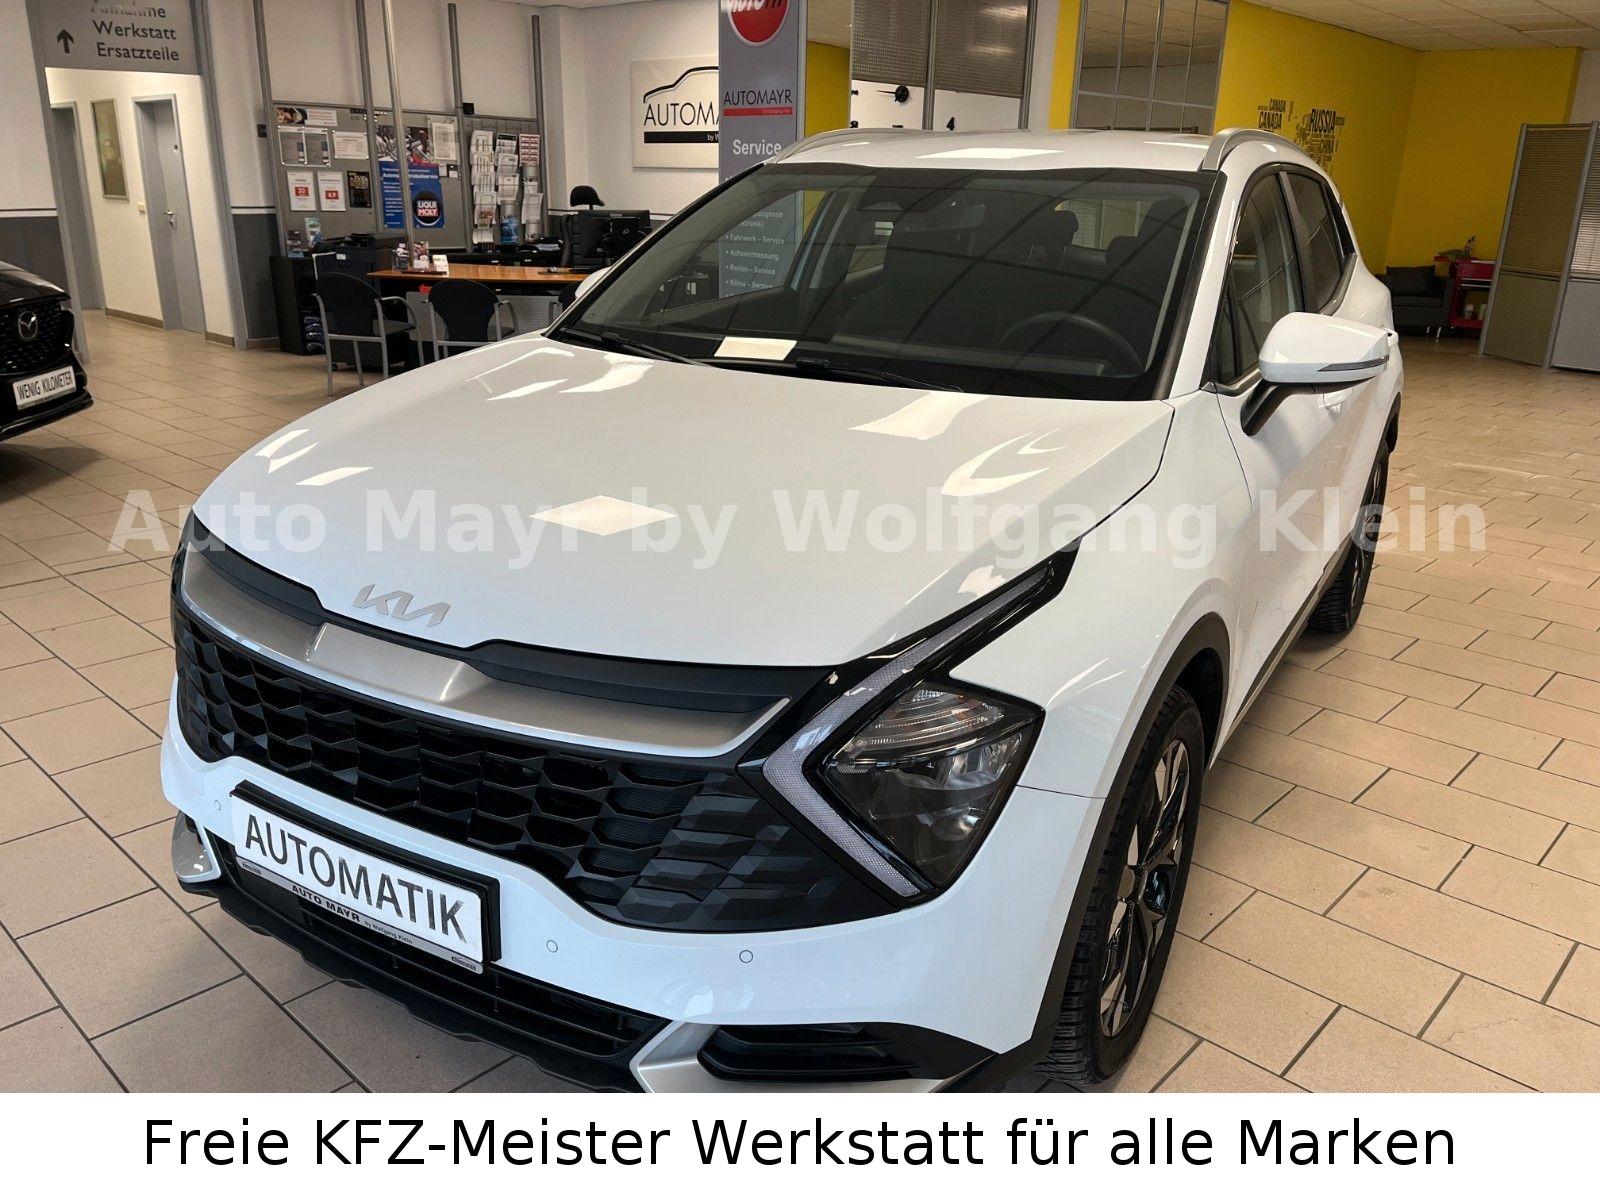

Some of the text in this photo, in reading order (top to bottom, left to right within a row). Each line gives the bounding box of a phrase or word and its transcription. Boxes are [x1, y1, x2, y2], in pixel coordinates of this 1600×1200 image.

[92, 20, 177, 40] Werkstatt
[96, 42, 180, 61] Ersatzteile
[723, 89, 793, 105] AUTOMAYR
[1259, 111, 1282, 129] CANADA
[1309, 108, 1336, 133] RUSSIA
[733, 139, 782, 155] Service
[417, 208, 438, 216] MOLY
[16, 371, 73, 400] WENIG KILOMETER
[245, 814, 467, 943] AUTOMATIK
[292, 884, 322, 906] AUTO
[326, 901, 360, 922] MAYR
